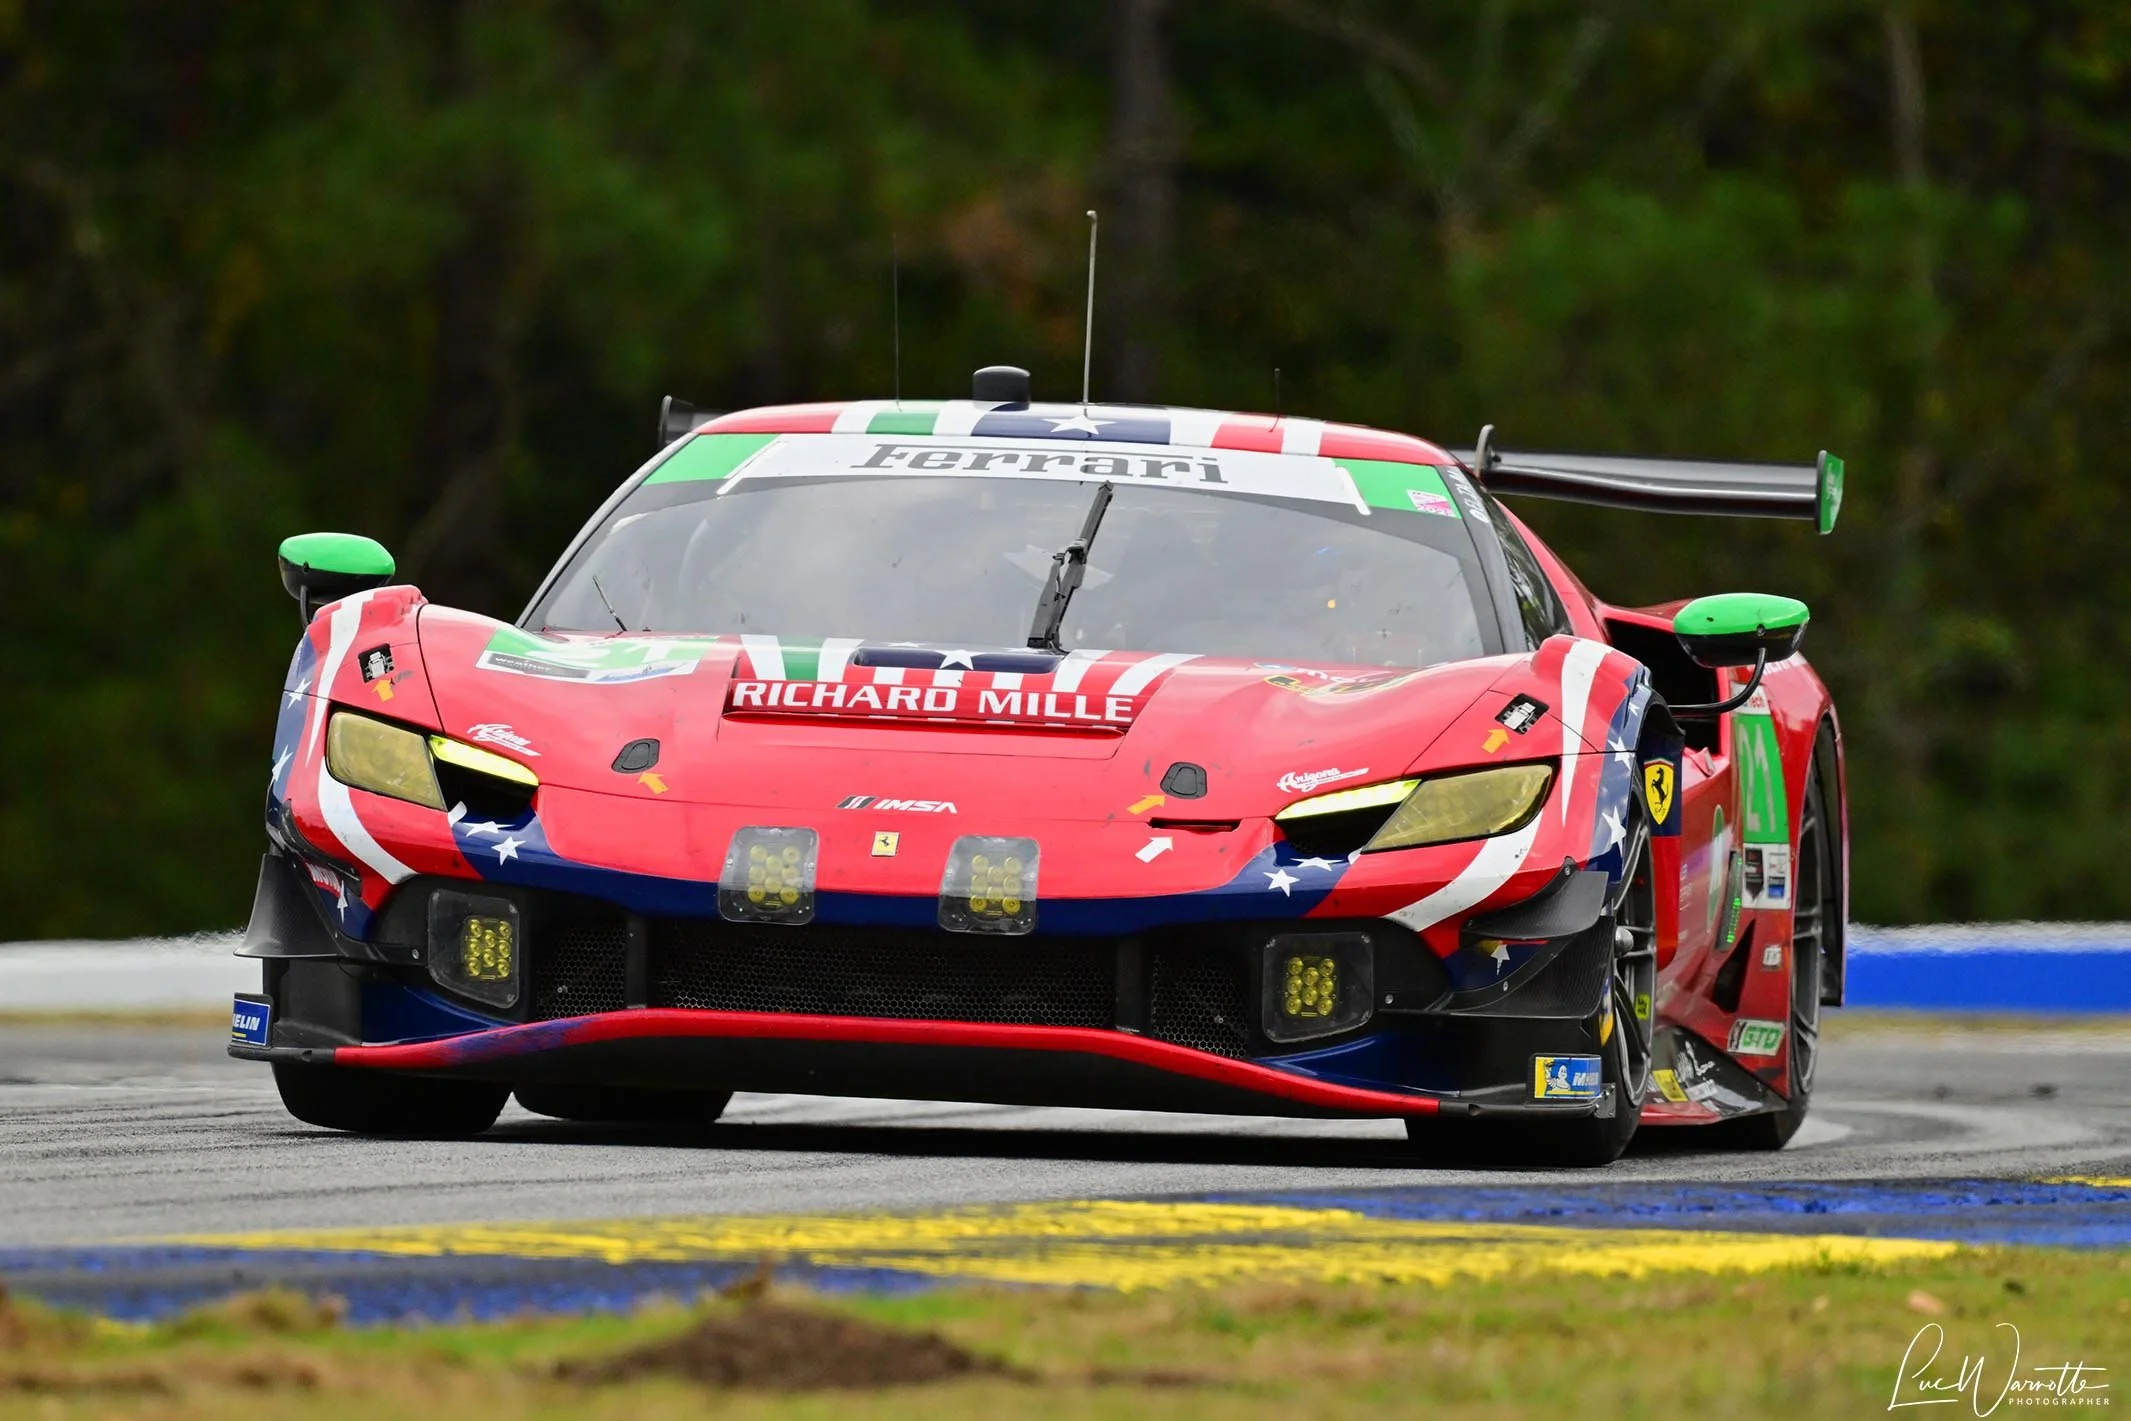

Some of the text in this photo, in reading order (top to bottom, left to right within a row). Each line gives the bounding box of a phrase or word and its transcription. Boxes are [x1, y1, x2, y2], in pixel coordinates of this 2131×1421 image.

[850, 443, 1228, 483] Ferrari
[732, 682, 1134, 723] RICHARD MILLE
[1738, 722, 1776, 834] 21
[873, 798, 958, 814] IMSA
[1743, 1025, 1781, 1050] GTD
